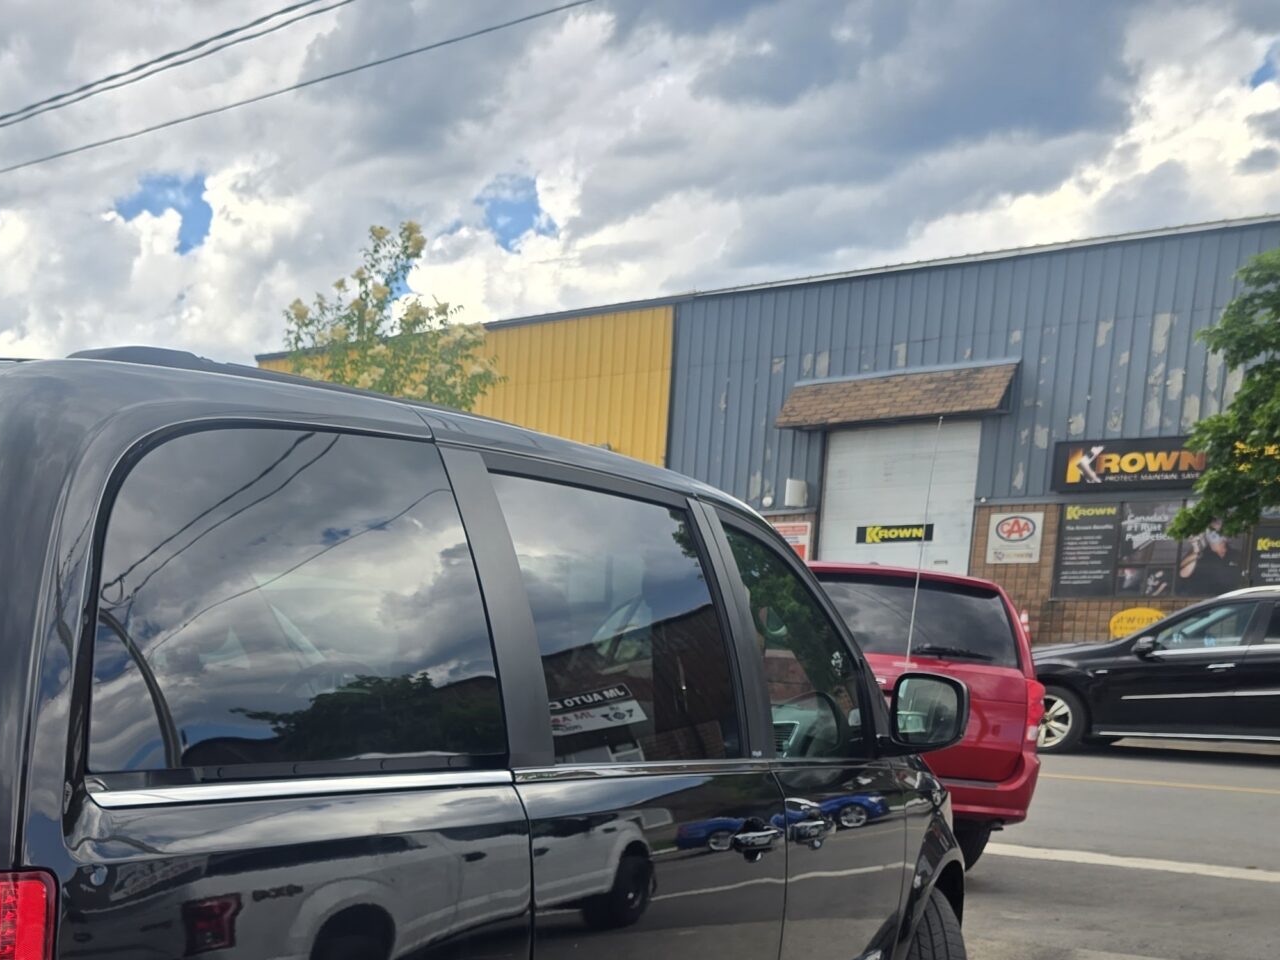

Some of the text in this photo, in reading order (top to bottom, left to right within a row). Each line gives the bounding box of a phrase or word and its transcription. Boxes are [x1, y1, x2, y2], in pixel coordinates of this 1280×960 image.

[1066, 445, 1206, 484] KROWN
[1066, 506, 1117, 520] KROWN
[865, 525, 925, 544] KROWN
[1000, 517, 1032, 539] CAA
